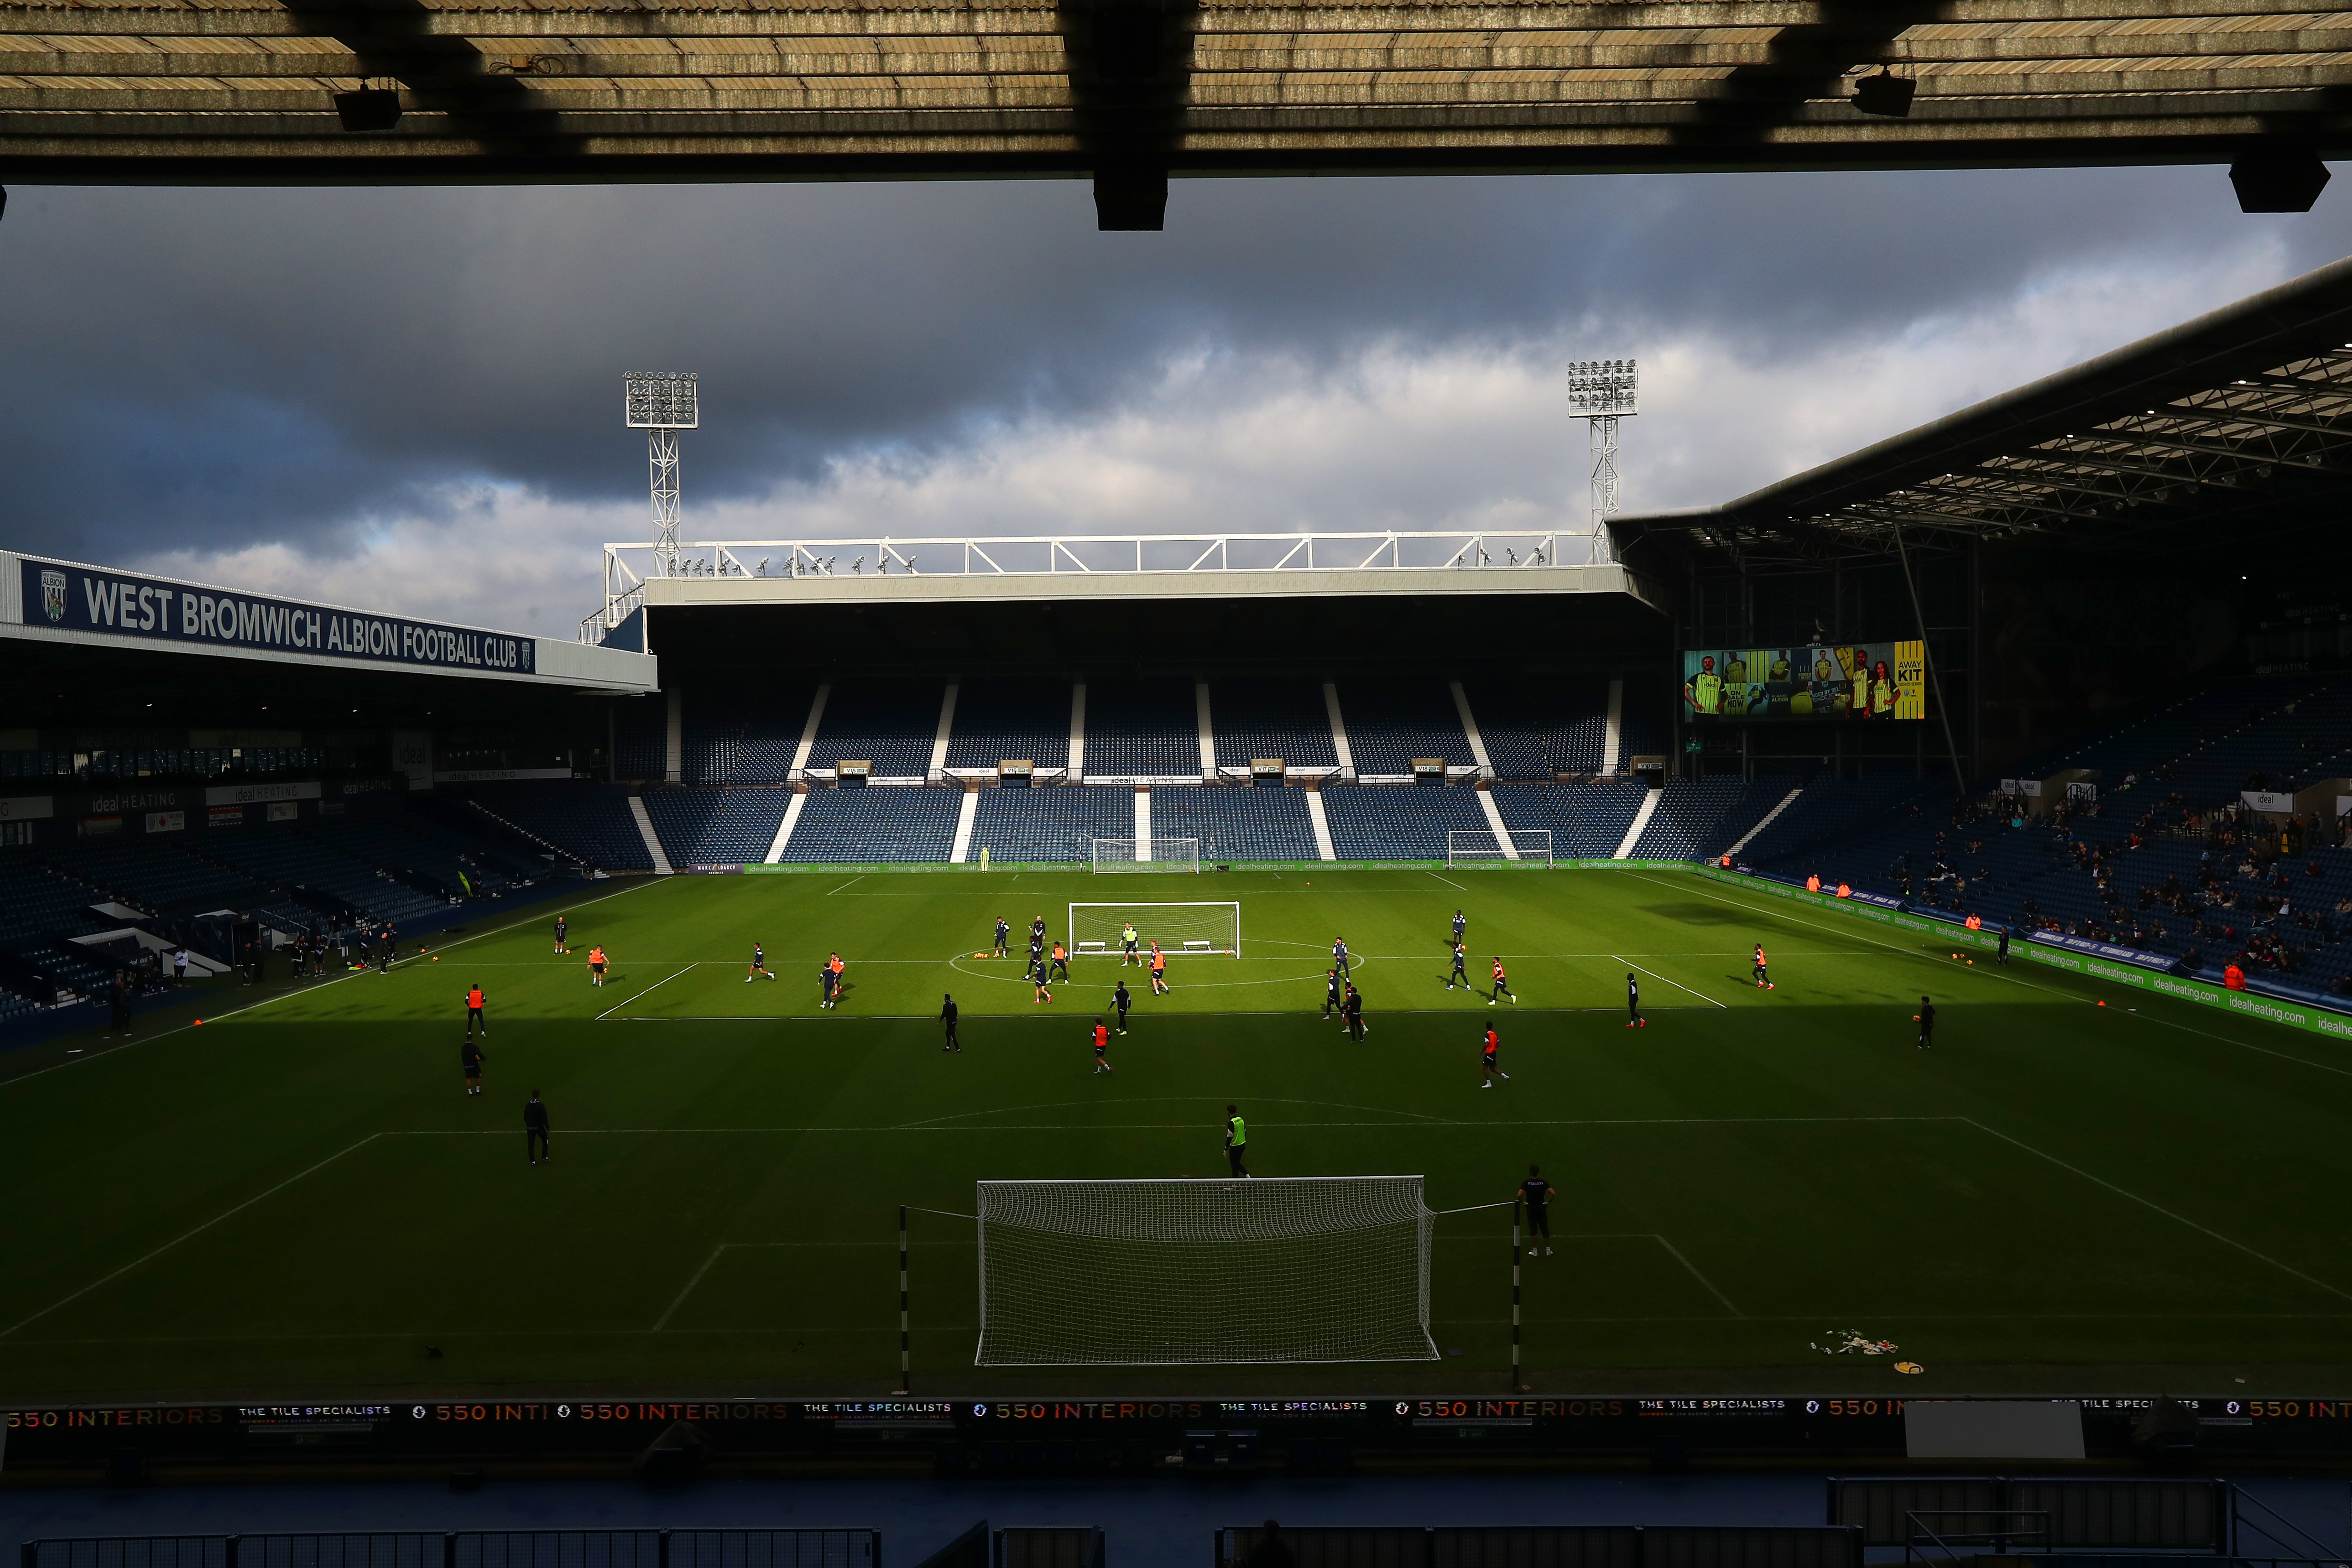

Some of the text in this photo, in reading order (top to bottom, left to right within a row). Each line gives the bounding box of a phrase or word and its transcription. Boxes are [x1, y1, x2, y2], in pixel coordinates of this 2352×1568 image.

[43, 577, 64, 587] ALBION
[2285, 609, 2300, 617] ideal
[84, 578, 516, 667] WEST BROMWICH ALBION FOOTBALL CLUB
[1898, 661, 1921, 669] AWAY
[2256, 666, 2273, 674] ideal
[1898, 669, 1922, 682] KIT
[400, 740, 425, 765] ideal
[449, 771, 516, 781] ideal HEATING
[2004, 780, 2014, 788] ideal
[236, 786, 297, 802] ideal HEATING
[344, 780, 391, 794] ideal HEATING
[93, 793, 175, 812] ideal HEATING
[2258, 794, 2274, 803] ideal
[749, 865, 808, 874] idealheating.com
[1795, 890, 1822, 907] idealheating.com
[1825, 897, 1855, 913] idealheating.com
[1858, 906, 1890, 922] idealheating.com
[1894, 915, 1930, 932] idealheating.com
[1935, 924, 1974, 943] idealheating.com
[2030, 946, 2080, 970] idealheating.com
[2087, 956, 2144, 986] idealheating.com
[2154, 969, 2219, 1003] idealheating.com
[2230, 995, 2305, 1025] idealheating.com
[239, 1406, 391, 1416] THE TILE SPECIALISTS
[580, 1404, 788, 1419] 550 INTERIORS
[996, 1403, 1202, 1419] 550 INTERIORS
[1419, 1401, 1624, 1417] 550 INTERIORS
[1639, 1401, 1664, 1409] THE
[1702, 1400, 1785, 1409] SPECIALISTS
[1829, 1400, 1877, 1415] 550
[2082, 1400, 2109, 1408] TILE
[2249, 1401, 2300, 1417] 550
[7, 1408, 223, 1427] 550 INTERIORS
[436, 1405, 486, 1420] 550
